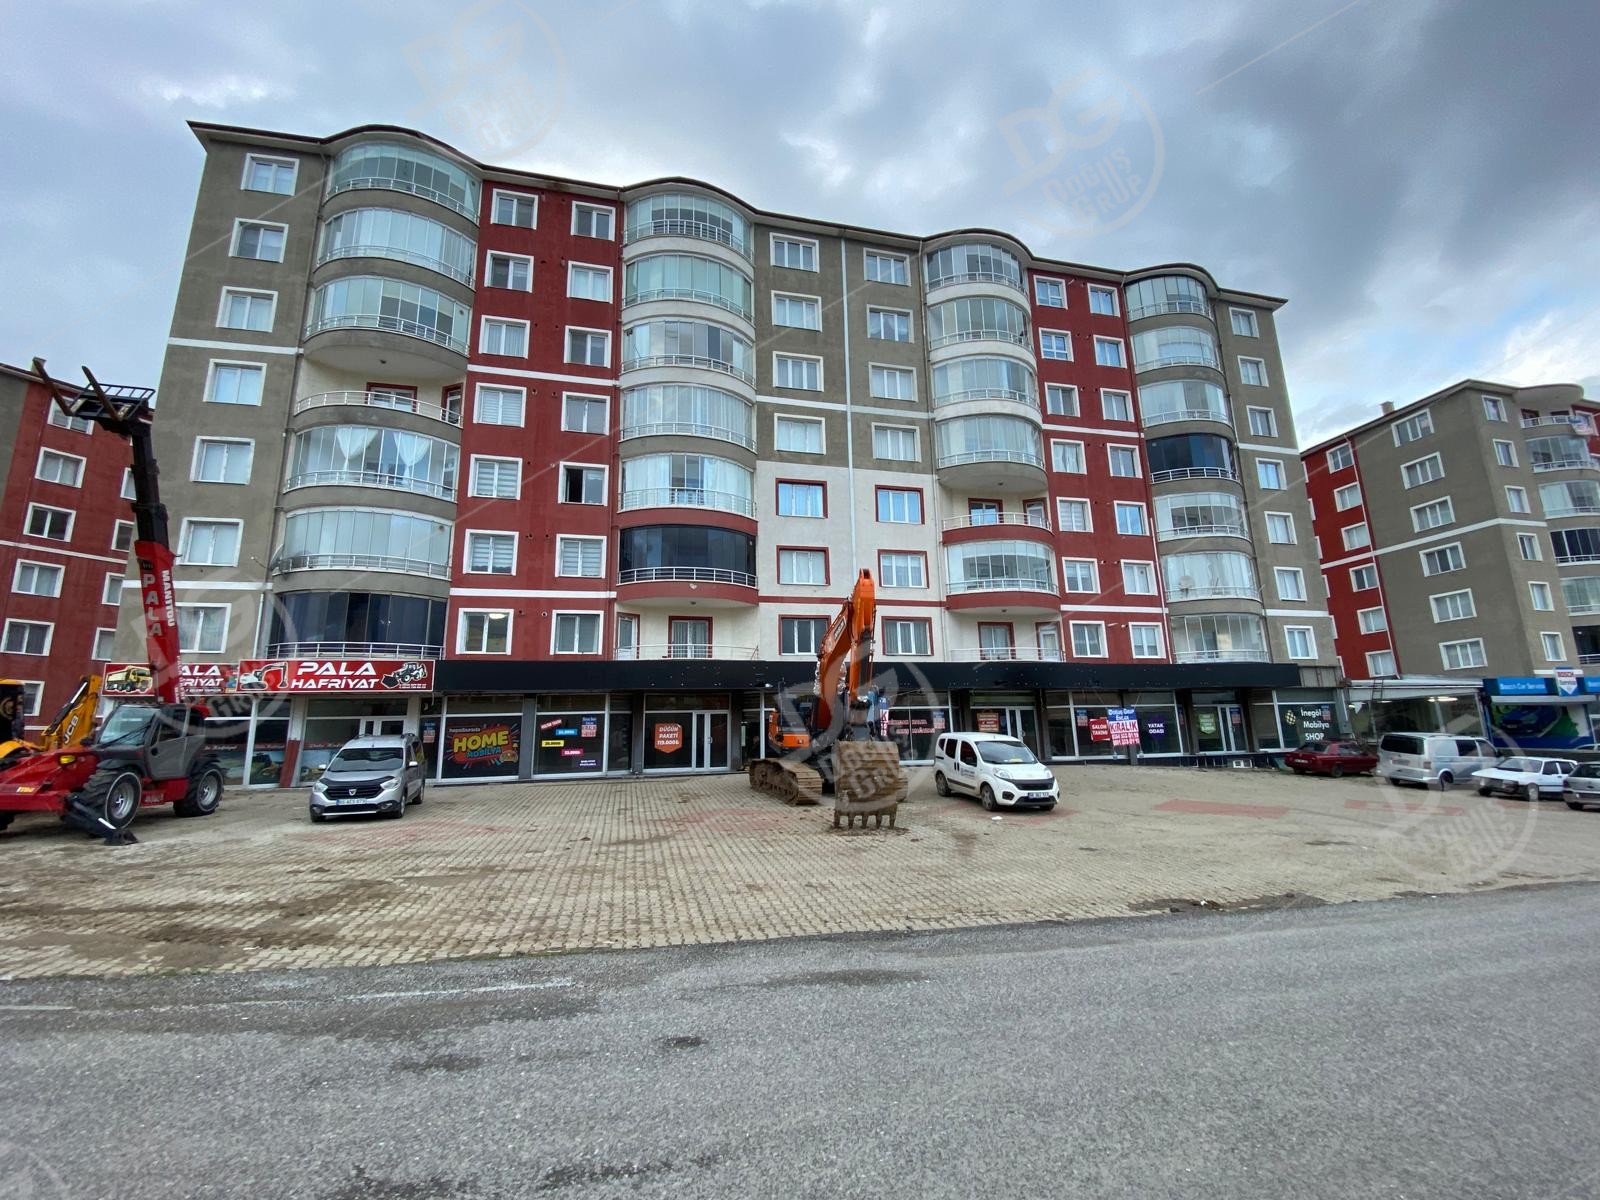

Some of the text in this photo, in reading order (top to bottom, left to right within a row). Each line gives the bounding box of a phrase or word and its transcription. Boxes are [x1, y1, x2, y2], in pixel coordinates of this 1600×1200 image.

[143, 573, 163, 637] PALA
[161, 569, 175, 628] MANITOU
[181, 665, 221, 676] ALA
[297, 662, 377, 676] PALA
[183, 677, 224, 687] RİYAT
[290, 677, 380, 689] HAFRİYAT
[64, 715, 79, 745] JCB
[1303, 721, 1329, 730] Mobilya
[453, 730, 509, 753] HOME
